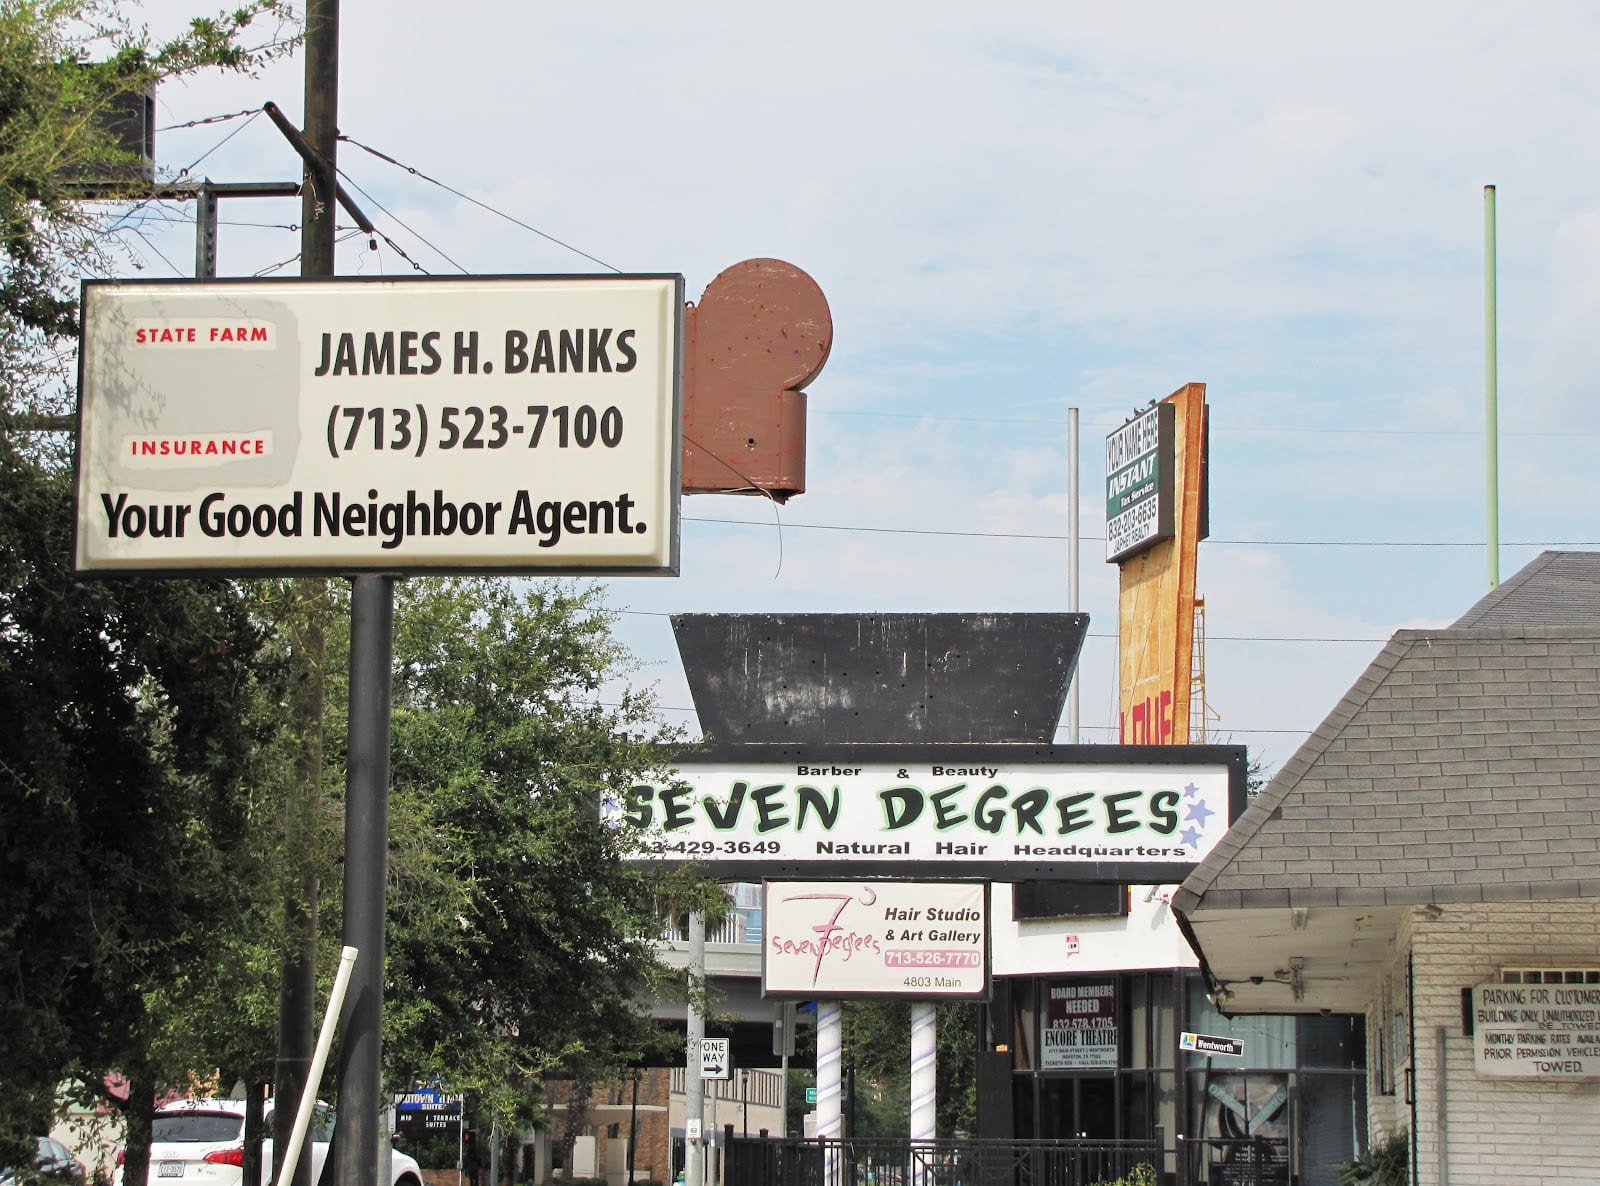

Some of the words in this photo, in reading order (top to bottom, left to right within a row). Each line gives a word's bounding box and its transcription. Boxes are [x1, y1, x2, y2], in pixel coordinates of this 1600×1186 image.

[136, 328, 196, 343] STATE
[210, 327, 268, 342] FARM
[315, 331, 441, 376] JAMES
[454, 332, 493, 374] H.
[504, 329, 637, 374] BANKS
[327, 404, 429, 458] (713)
[440, 405, 624, 449] 523-7100
[132, 440, 264, 455] INSURANCE
[1107, 431, 1124, 472] YOUR
[1124, 420, 1141, 464] NAME
[1141, 410, 1158, 453] HERE
[1109, 453, 1156, 499] INSTANT
[1132, 482, 1154, 500] Service
[100, 493, 191, 538] Your
[199, 492, 302, 537] Good
[313, 489, 502, 549] Neighbor
[508, 490, 647, 547] Agent.
[1131, 523, 1150, 543] REALTY
[797, 766, 862, 776] Barber
[896, 768, 910, 778] &
[932, 766, 998, 778] Beauty
[623, 781, 842, 833] SEVEN
[879, 784, 1181, 835] DEGREES
[639, 841, 781, 854] 3-429-3649
[816, 841, 910, 854] Natural
[936, 842, 988, 855] Hair
[1014, 844, 1186, 858] Headquarters
[885, 908, 920, 921] Hair
[926, 908, 980, 921] Studio
[885, 931, 895, 940] &
[901, 931, 923, 941] Art
[928, 930, 981, 944] Gallery
[886, 951, 980, 965] 713-526-7770
[904, 977, 931, 987] 4803
[935, 977, 962, 987] Main
[1051, 987, 1076, 999] BOARD
[1077, 985, 1114, 998] MEMBERS
[1483, 989, 1526, 1006] PARKING
[1530, 990, 1549, 1004] FOR
[1066, 999, 1100, 1014] NEEDED
[1478, 1009, 1518, 1023] BUILDING
[1045, 1030, 1078, 1046] ENCORE
[1517, 1033, 1547, 1045] PARKING
[1550, 1034, 1571, 1044] RATES
[703, 1042, 725, 1051] ONE
[1197, 1039, 1234, 1053] Wentworth
[1484, 1048, 1512, 1060] PRIOR
[1516, 1048, 1561, 1059] PERMISSION
[1566, 1047, 1600, 1057] VEHICLE
[702, 1053, 725, 1062] WAY
[394, 1093, 434, 1104] MDTOWN
